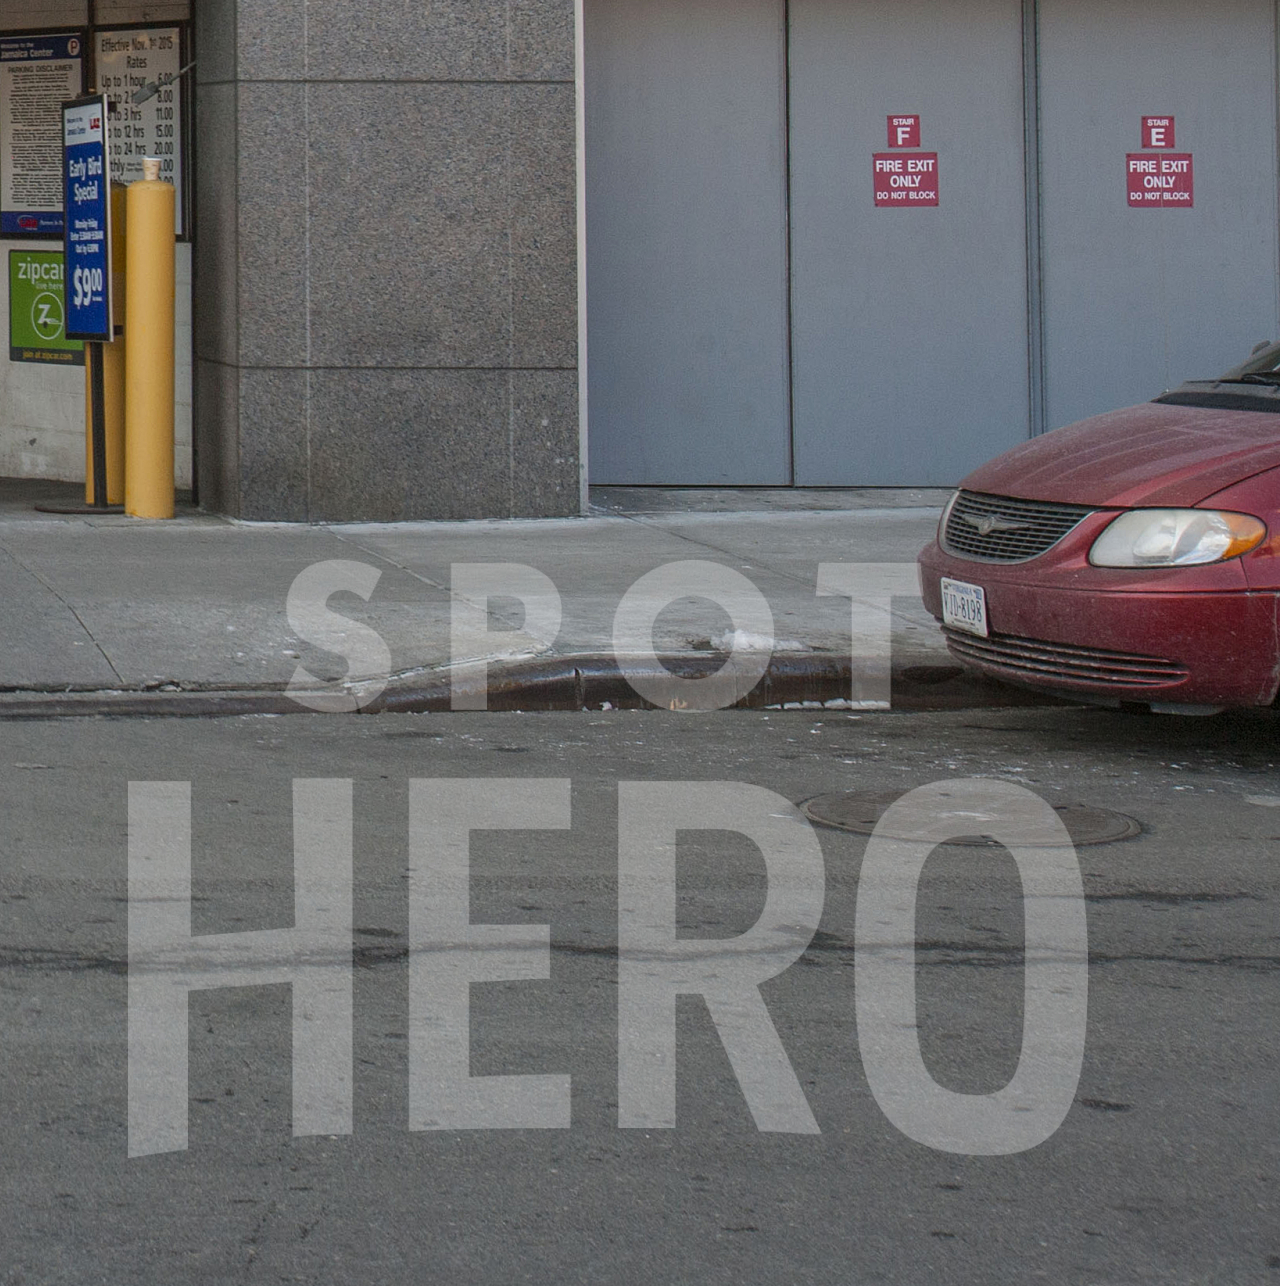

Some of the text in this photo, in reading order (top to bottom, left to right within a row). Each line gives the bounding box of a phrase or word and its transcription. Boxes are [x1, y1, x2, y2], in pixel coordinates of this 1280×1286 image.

[101, 38, 130, 52] Effective
[132, 37, 147, 51] Nov.
[158, 36, 174, 50] 2015
[126, 55, 148, 69] Rates
[7, 64, 74, 74] PARKING DISCLAIMER
[101, 75, 111, 91] Up
[113, 75, 122, 87] to
[129, 73, 147, 88] hour
[124, 91, 130, 104] 2
[157, 90, 174, 103] 8.00
[124, 108, 128, 121] 3
[130, 107, 142, 121] hrs
[155, 107, 173, 121] 11.00
[892, 118, 915, 126] STAIR
[1147, 118, 1170, 126] STAIR
[114, 126, 122, 138] to
[124, 125, 131, 138] 12
[133, 124, 145, 138] hrs
[155, 124, 174, 138] 15.00
[896, 128, 911, 145] F
[1151, 128, 1165, 146] E
[114, 143, 122, 155] to
[124, 142, 132, 155] 24
[135, 141, 146, 155] hrs
[154, 142, 174, 155] 20.00
[69, 157, 87, 180] Early
[88, 155, 102, 176] Bird
[875, 160, 934, 173] FIRE EXIT
[1130, 160, 1189, 173] FIRE EXIT
[889, 175, 921, 188] ONLY
[1144, 175, 1176, 188] ONLY
[73, 180, 99, 205] Special
[875, 191, 936, 201] DO NOT BLOCK
[1130, 191, 1191, 201] DO NOT BLOCK
